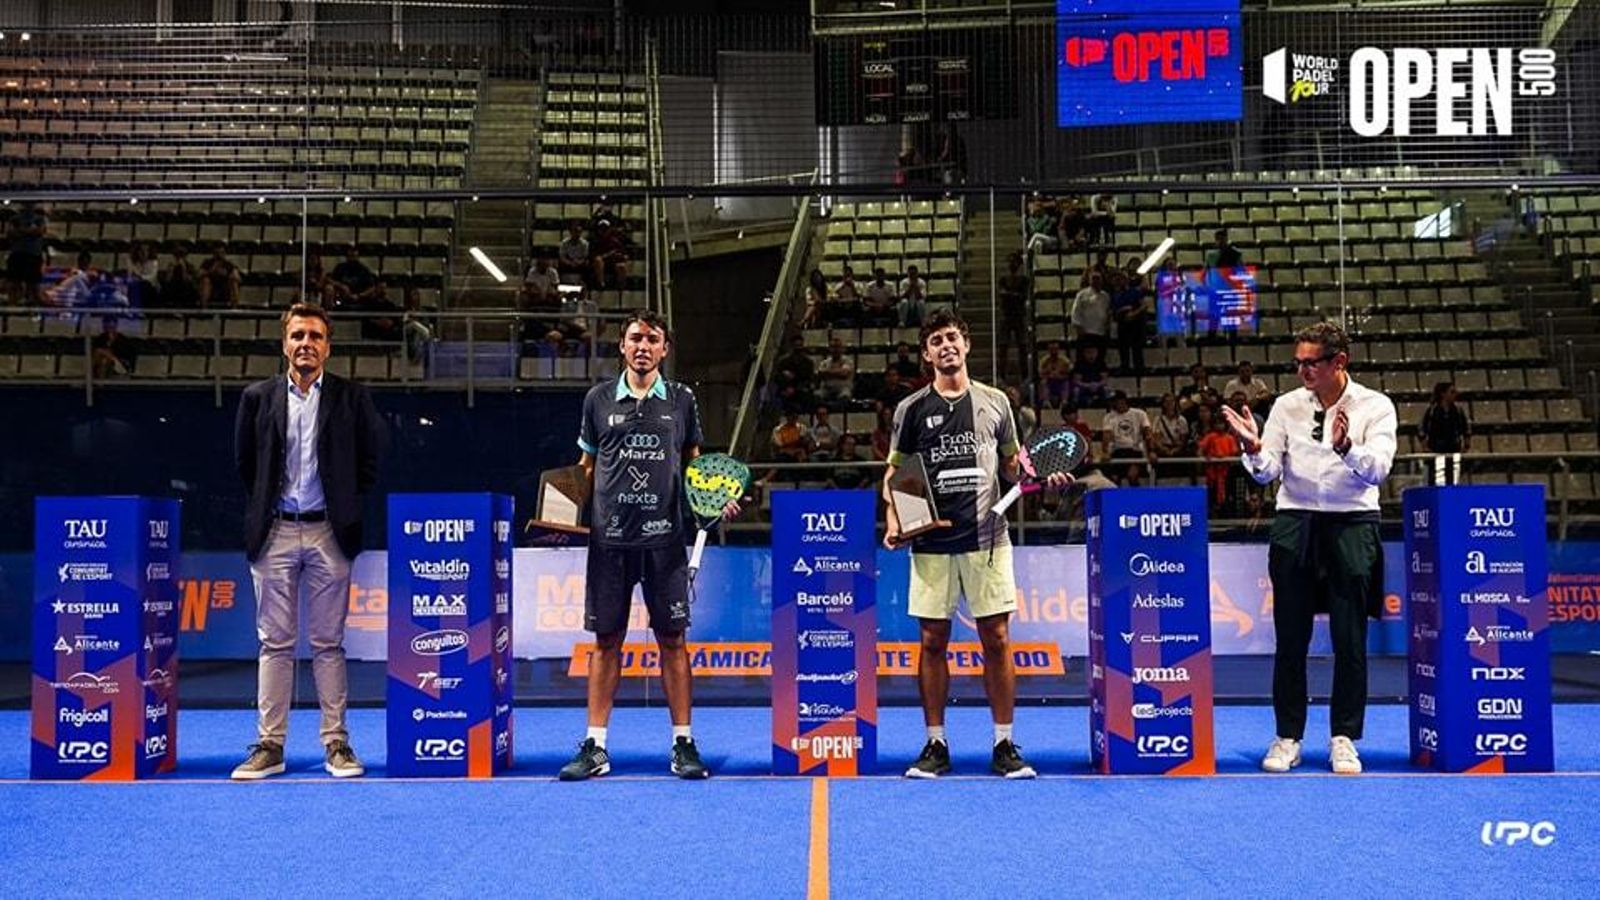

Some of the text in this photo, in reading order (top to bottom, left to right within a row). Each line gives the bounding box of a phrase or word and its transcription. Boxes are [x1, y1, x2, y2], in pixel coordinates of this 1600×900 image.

[1113, 30, 1206, 82] OPEN
[864, 63, 894, 74] LOCAL
[619, 449, 666, 461] Marzá
[801, 512, 846, 532] TAU
[1469, 507, 1516, 527] TAU
[64, 519, 108, 539] TAU
[424, 519, 465, 542] OPEN
[1140, 513, 1181, 537] OPEN
[409, 559, 470, 574] Vitaldin
[814, 561, 861, 572] Alicante
[1140, 560, 1185, 574] Midea
[412, 594, 466, 606] MAX
[797, 592, 854, 605] Barceló
[1132, 593, 1185, 608] Adeslas
[67, 602, 120, 614] ESTRELLA
[414, 634, 466, 650] conguitos
[1140, 634, 1199, 642] CUPRA
[1487, 630, 1534, 641] Alicante
[74, 639, 120, 651] Alicante
[1478, 699, 1522, 714] GDN
[415, 739, 465, 755] UPC
[812, 736, 853, 759] OPEN
[1137, 736, 1189, 752] UPC
[1475, 734, 1528, 750] UPC
[59, 742, 108, 758] UPC
